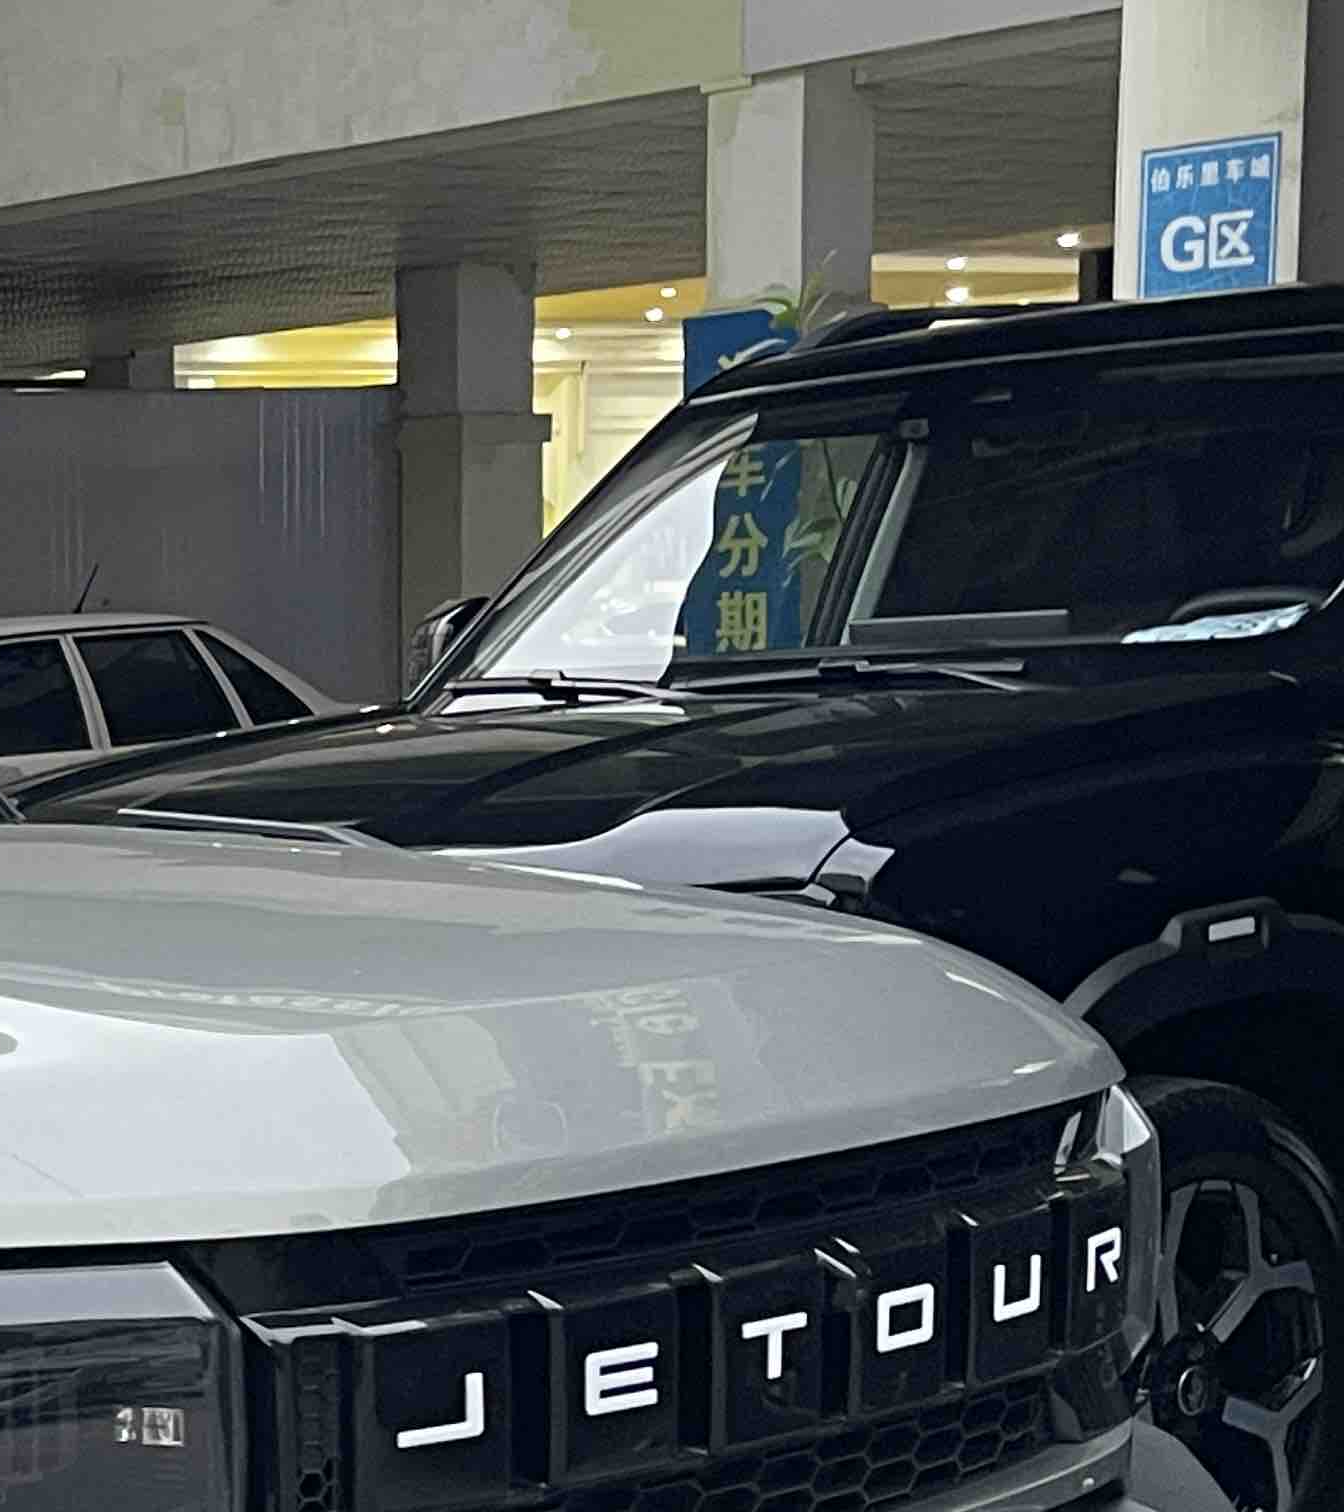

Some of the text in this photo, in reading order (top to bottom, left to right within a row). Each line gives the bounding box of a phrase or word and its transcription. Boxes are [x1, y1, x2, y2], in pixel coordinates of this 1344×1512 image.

[1160, 208, 1255, 273] G区
[715, 352, 770, 653] 车分期
[395, 1225, 1123, 1450] JETOUR
